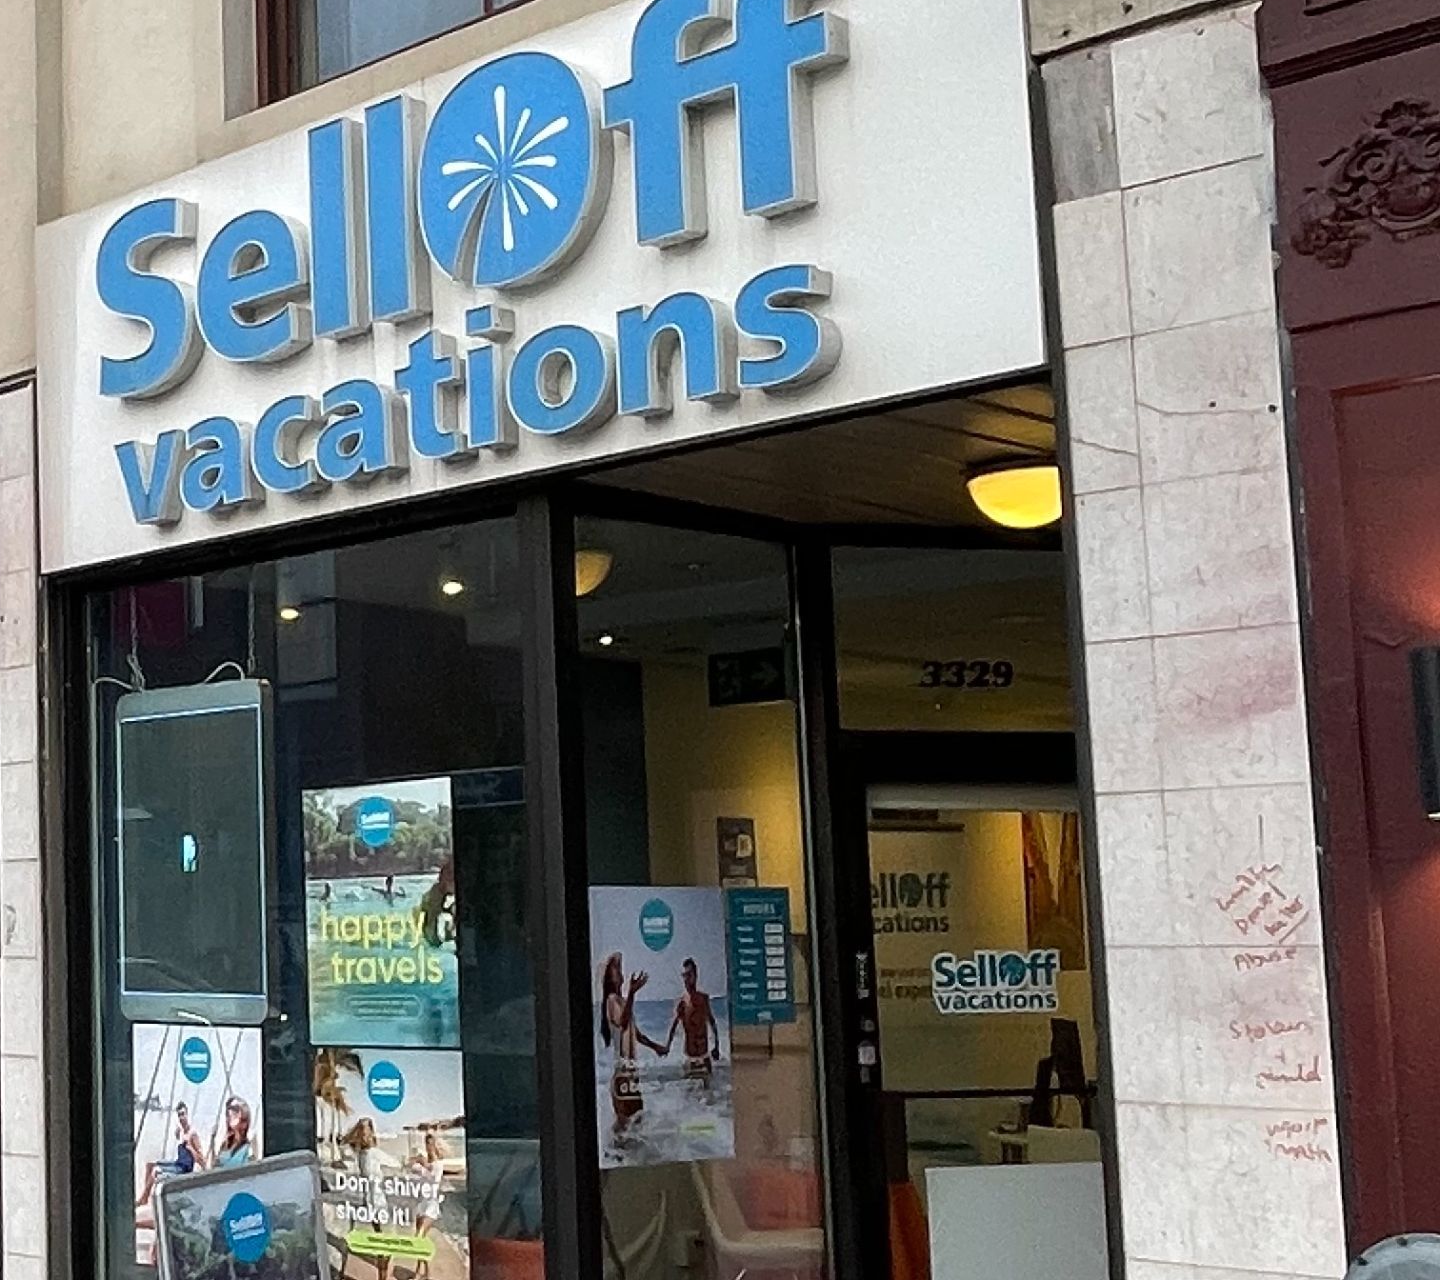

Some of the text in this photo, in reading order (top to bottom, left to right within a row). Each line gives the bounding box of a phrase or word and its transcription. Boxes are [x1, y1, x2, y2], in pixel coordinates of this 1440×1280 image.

[114, 264, 844, 527] vacations
[918, 660, 1015, 688] 3329
[870, 871, 952, 908] ellOff
[319, 904, 427, 951] happy
[873, 913, 950, 933] cations
[330, 945, 445, 986] travels
[934, 952, 1057, 988] SellOff
[936, 992, 1057, 1010] vacations
[335, 1172, 446, 1204] Don't shiver,
[335, 1200, 411, 1227] shake it!
